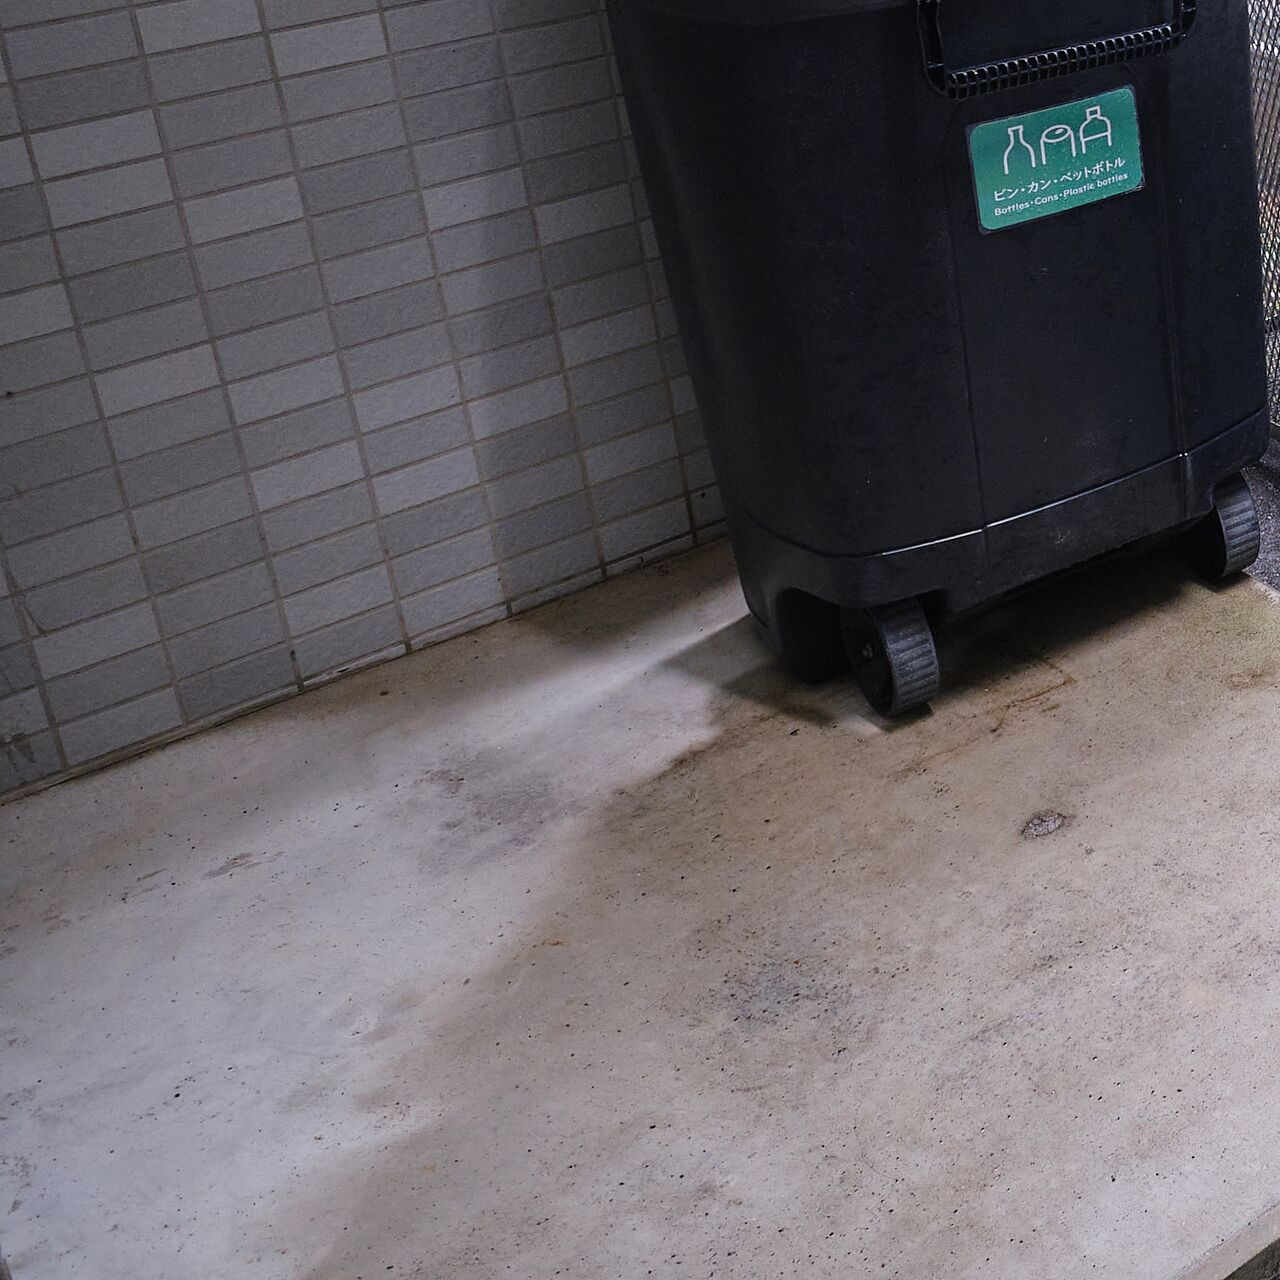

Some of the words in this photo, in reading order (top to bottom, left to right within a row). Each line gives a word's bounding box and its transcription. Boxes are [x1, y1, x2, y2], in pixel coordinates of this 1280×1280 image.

[993, 157, 1127, 202] ビン・カン・ペットボトル
[1096, 172, 1129, 188] bottles
